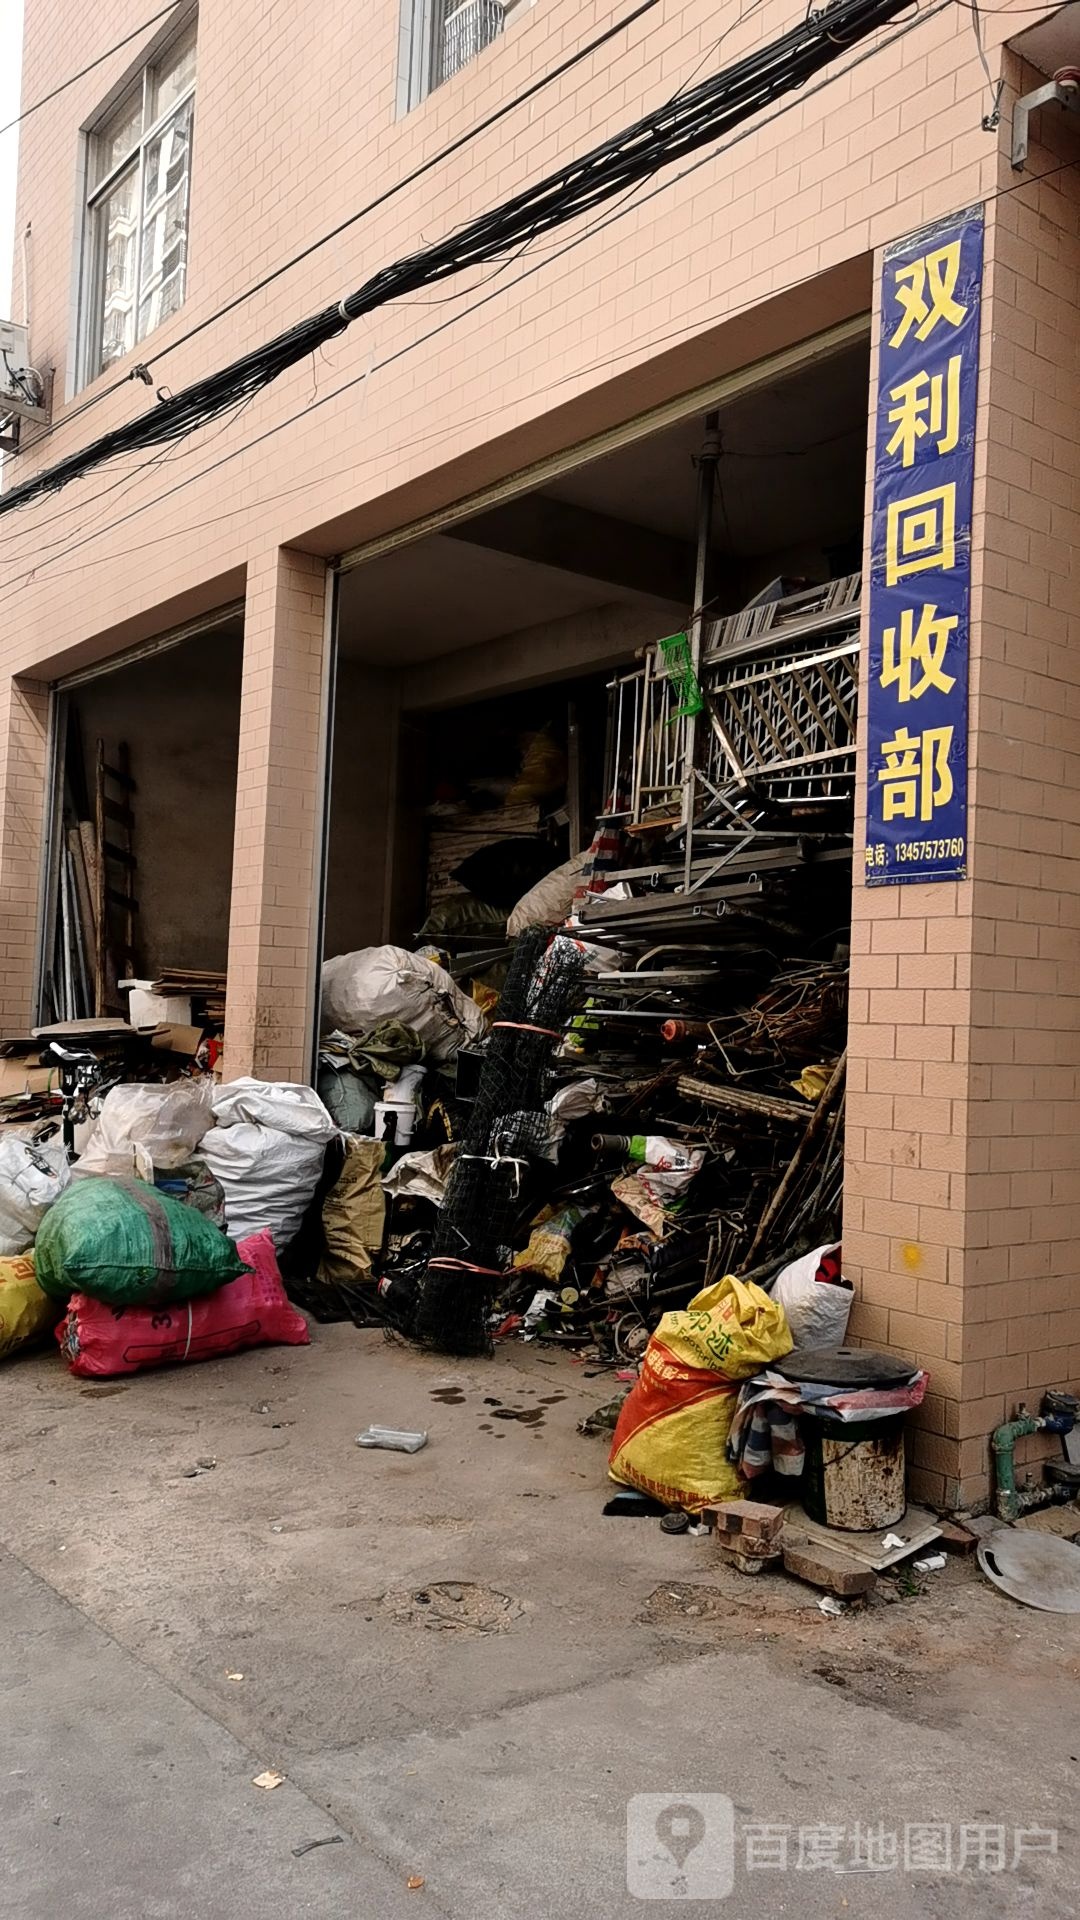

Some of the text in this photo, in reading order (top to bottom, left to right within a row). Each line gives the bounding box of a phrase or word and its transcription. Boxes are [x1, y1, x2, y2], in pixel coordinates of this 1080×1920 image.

[878, 239, 968, 822] 双利回收部
